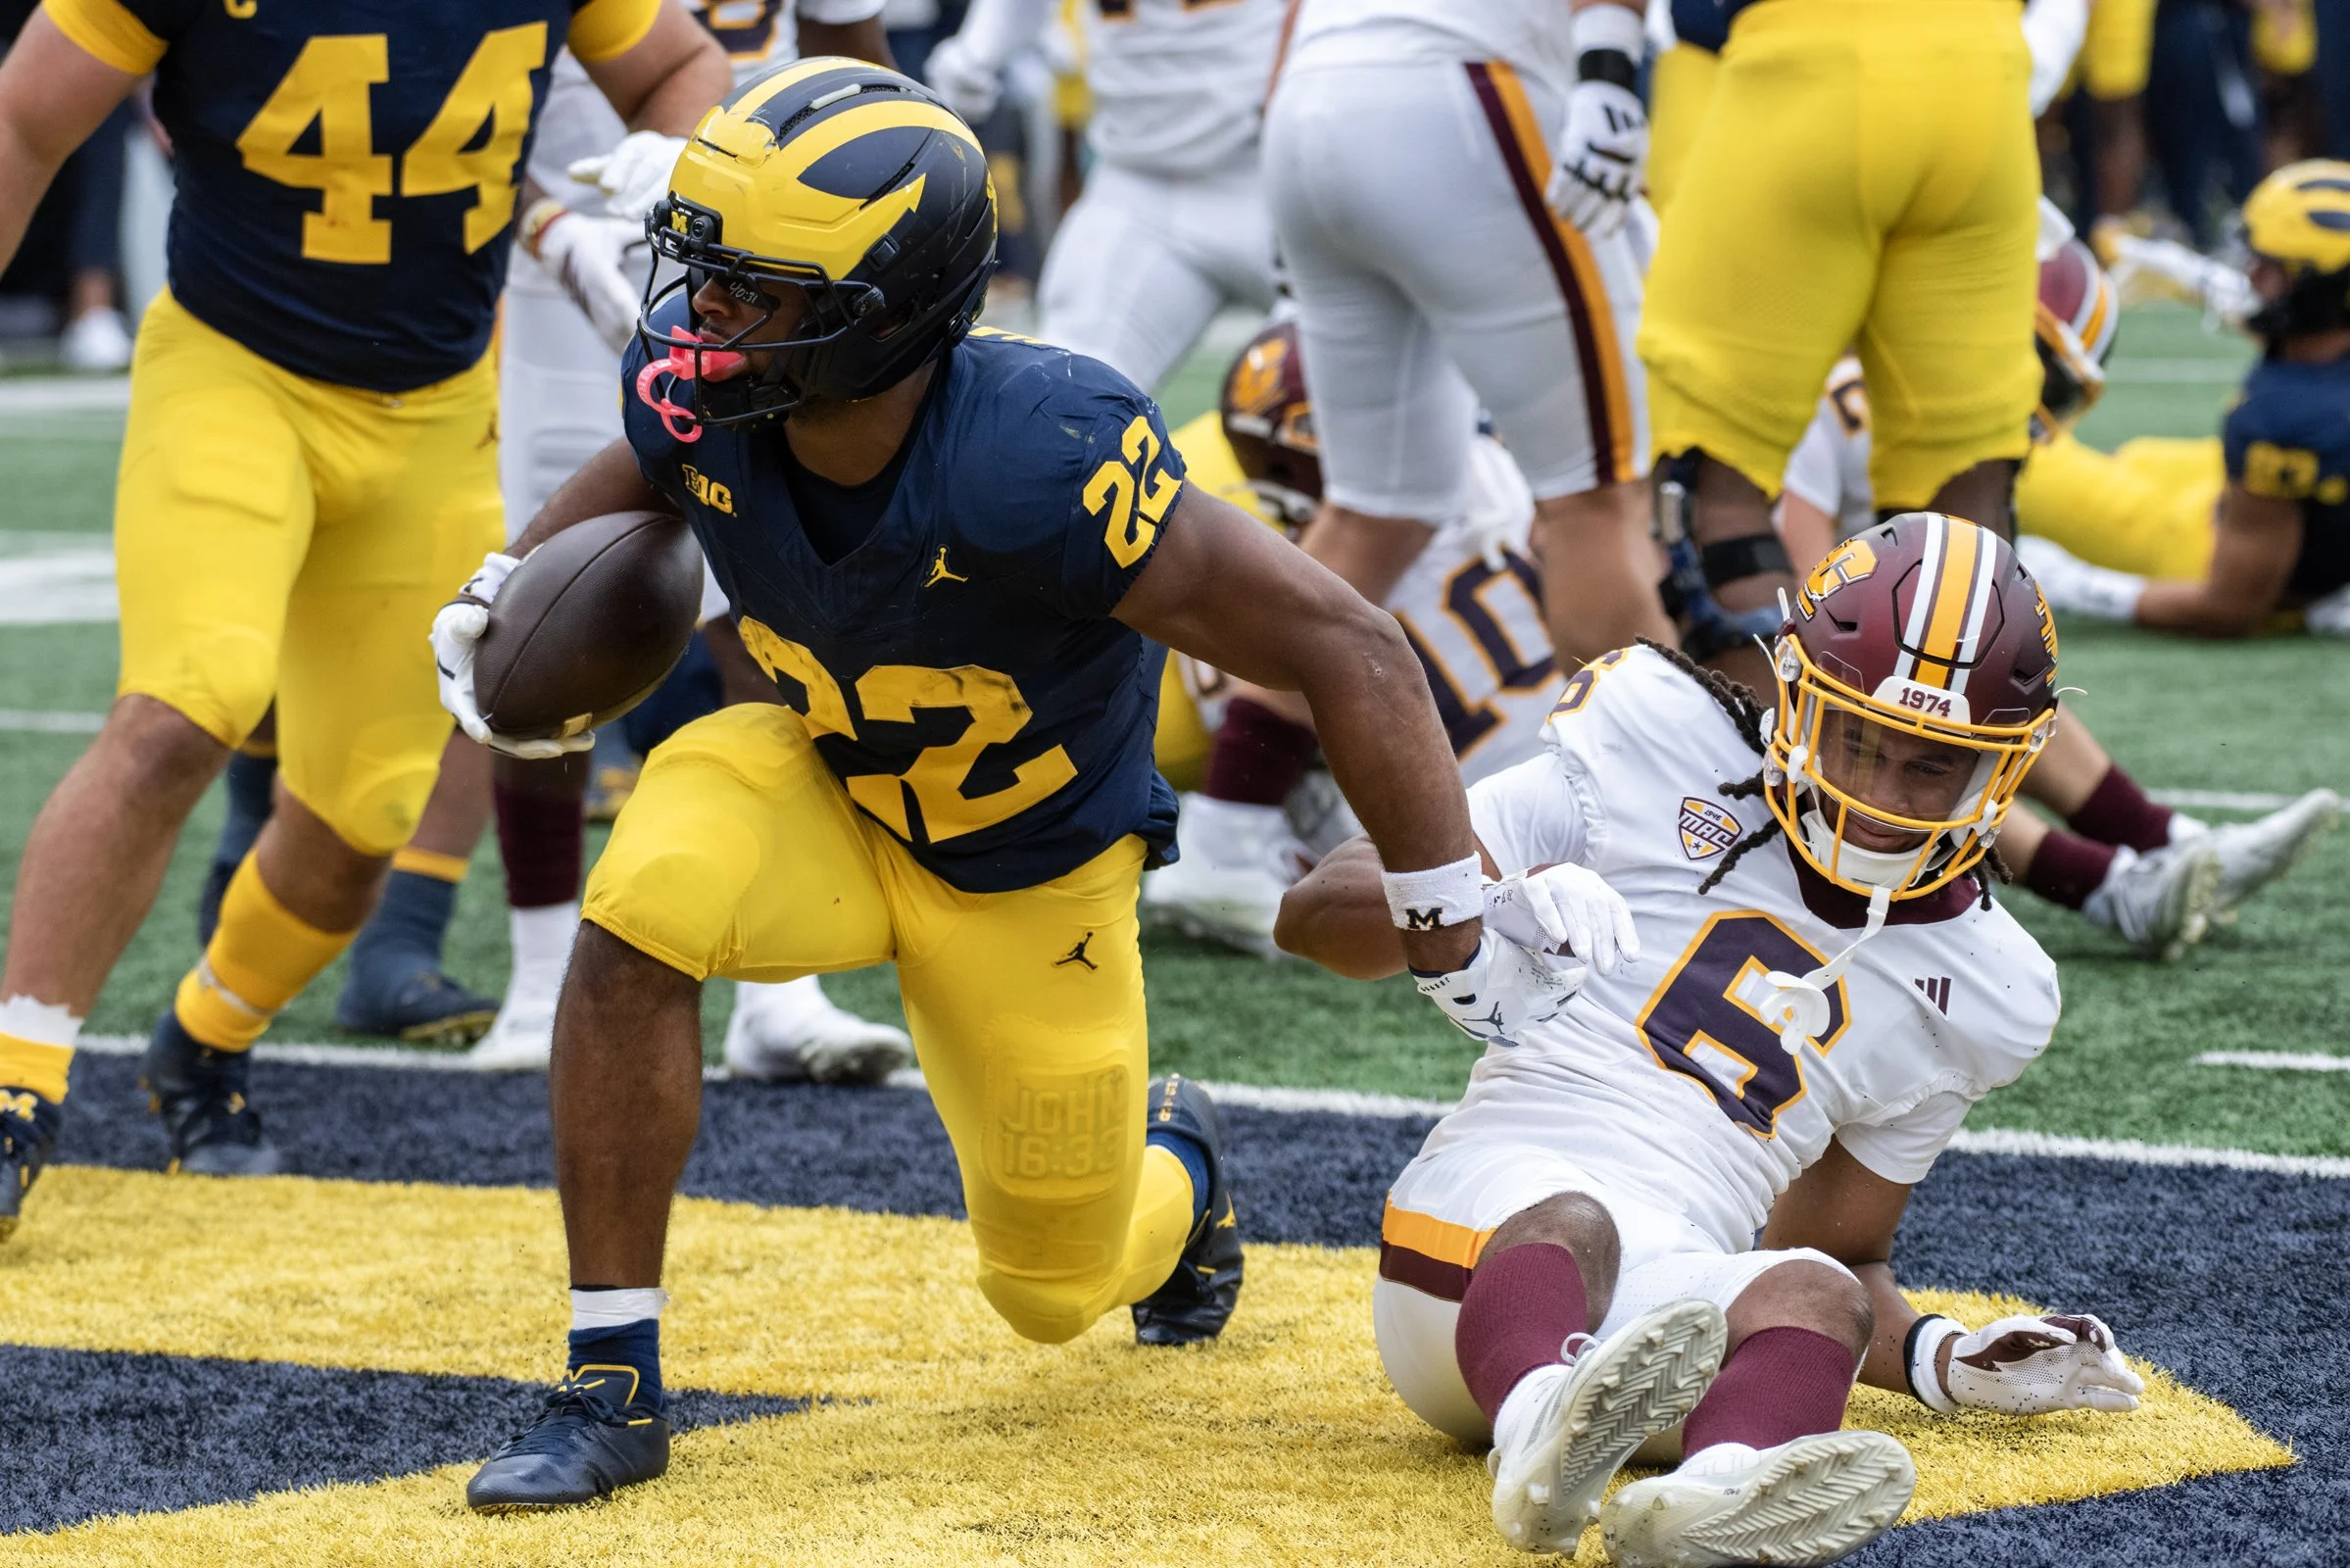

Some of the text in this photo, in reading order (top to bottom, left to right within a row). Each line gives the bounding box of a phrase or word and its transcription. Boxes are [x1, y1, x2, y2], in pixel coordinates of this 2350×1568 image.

[236, 21, 548, 265] 44
[1083, 416, 1184, 569] 22
[738, 614, 1079, 844] 22
[1392, 541, 1558, 764] 10
[1898, 686, 1951, 717] 1974
[1405, 906, 1444, 930] M
[1679, 808, 1735, 846] MAC
[1635, 909, 1851, 1141] 6
